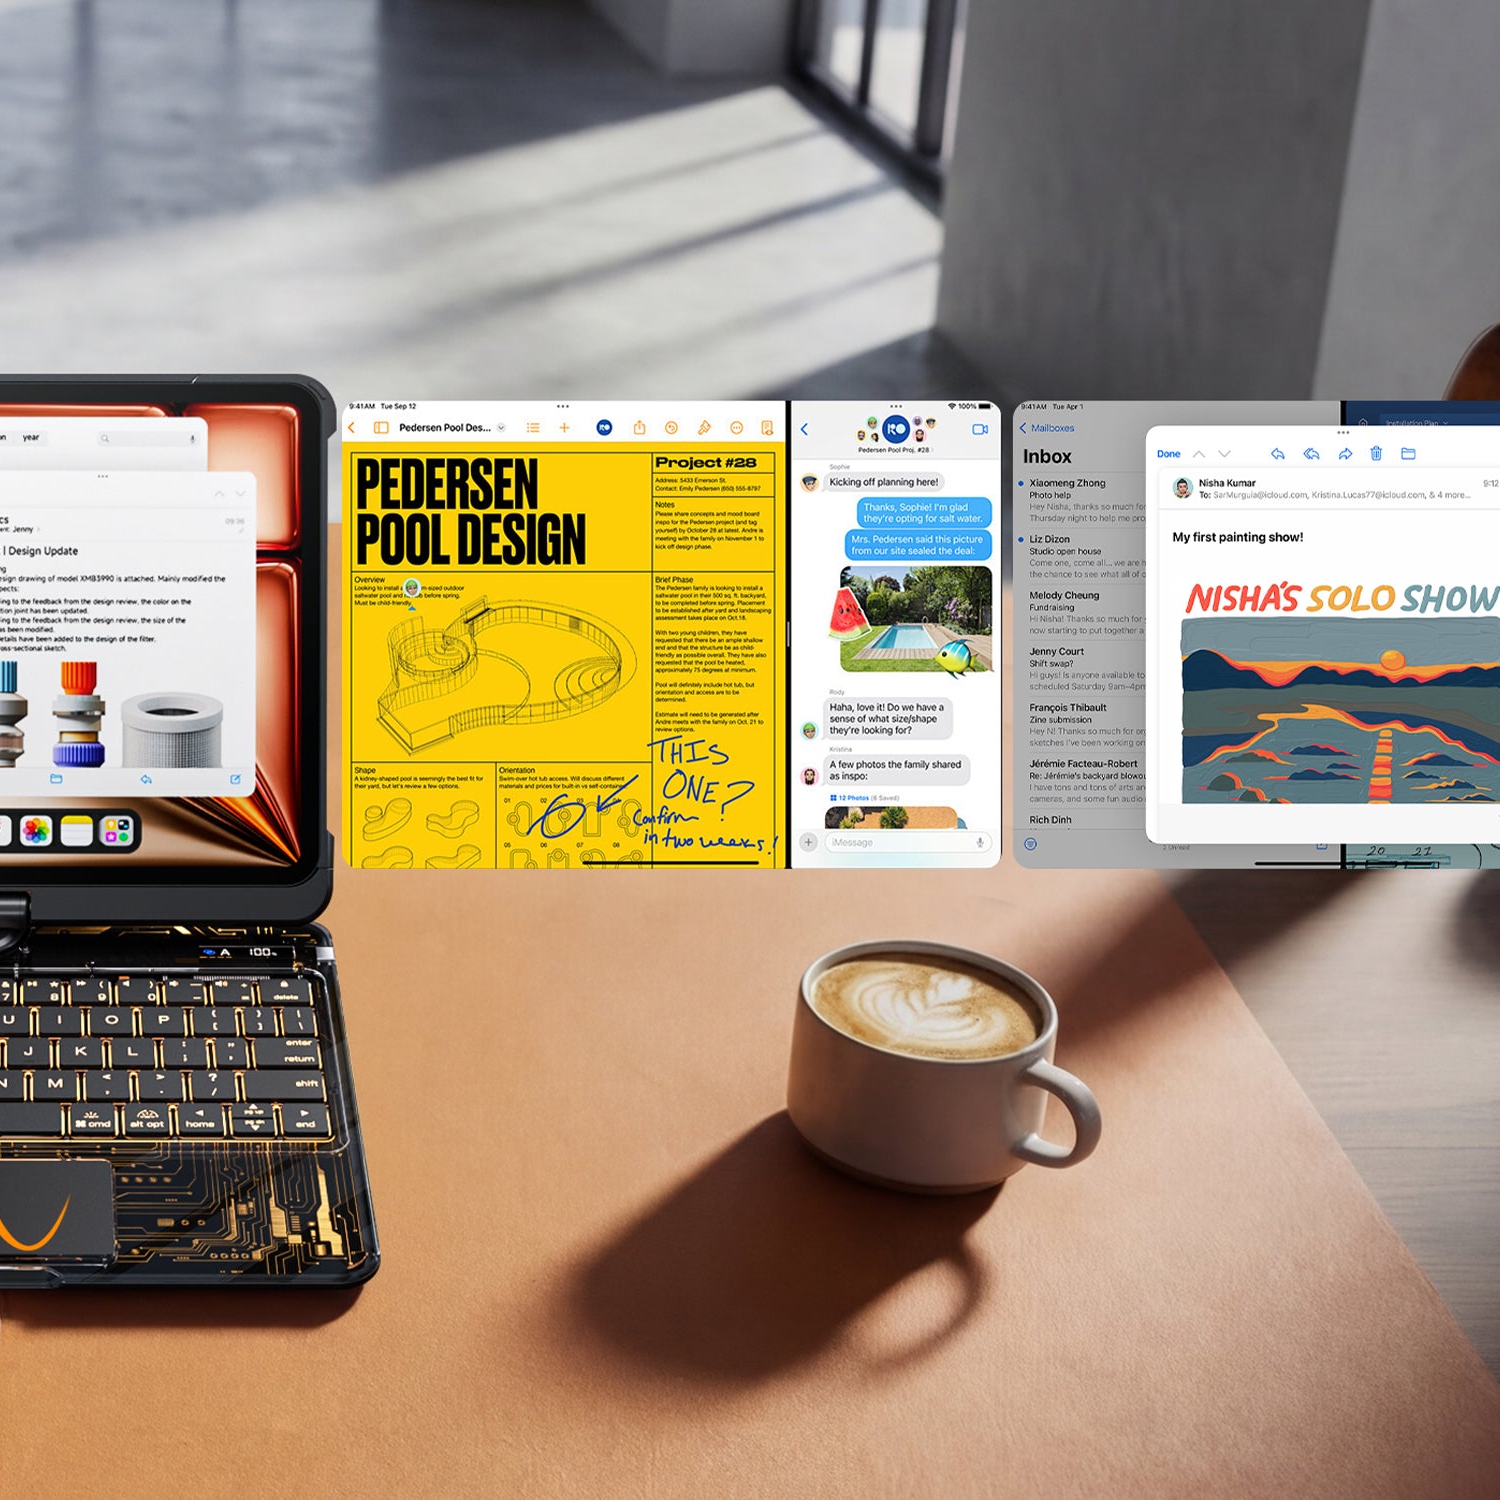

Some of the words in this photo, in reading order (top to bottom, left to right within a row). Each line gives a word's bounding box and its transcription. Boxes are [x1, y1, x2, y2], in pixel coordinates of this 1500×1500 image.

[399, 422, 443, 433] Pedersen
[443, 422, 464, 433] Pool
[465, 422, 492, 433] Des...
[1031, 423, 1075, 433] Mailboxes
[22, 434, 40, 443] year
[1023, 448, 1072, 464] Inbox
[1157, 449, 1181, 459] Done
[655, 456, 722, 471] Project
[725, 457, 758, 469] #28
[357, 457, 538, 510] PEDERSEN
[829, 477, 862, 489] Kicking
[862, 477, 876, 487] off
[877, 477, 915, 489] planning
[916, 477, 939, 487] here!
[1029, 478, 1075, 490] Xiaomeng
[1076, 478, 1106, 490] Zhong
[1198, 478, 1225, 488] Nisha
[1226, 478, 1257, 488] Kumar
[654, 501, 676, 509] Notes
[357, 513, 451, 566] POOL
[457, 513, 586, 566] DESIGN
[1172, 531, 1191, 545] My
[1192, 531, 1217, 543] first
[1219, 531, 1266, 545] painting
[1268, 531, 1304, 543] show!
[8, 545, 42, 558] Design
[43, 546, 79, 558] Update
[354, 575, 386, 584] Overview
[654, 575, 672, 585] Brief
[672, 575, 694, 585] Phase
[1186, 581, 1302, 613] NISHA'S
[1306, 585, 1395, 612] SOLO
[1401, 585, 1500, 613] SHOW
[1029, 702, 1069, 714] François
[1069, 703, 1107, 712] Thibault
[647, 735, 729, 765] THIS
[1029, 758, 1066, 769] Jérémie
[1067, 759, 1138, 769] Facteau-Robert
[354, 766, 377, 775] Shape
[497, 766, 536, 775] Orientation
[633, 808, 699, 827] Confirm
[644, 828, 659, 845] in
[663, 826, 695, 848] two
[3, 1014, 15, 1025] U
[104, 1014, 119, 1025] O
[157, 1014, 170, 1025] P
[285, 1038, 313, 1048] enter
[284, 1055, 316, 1063] return
[185, 1120, 215, 1128] home
[295, 1120, 316, 1128] end
